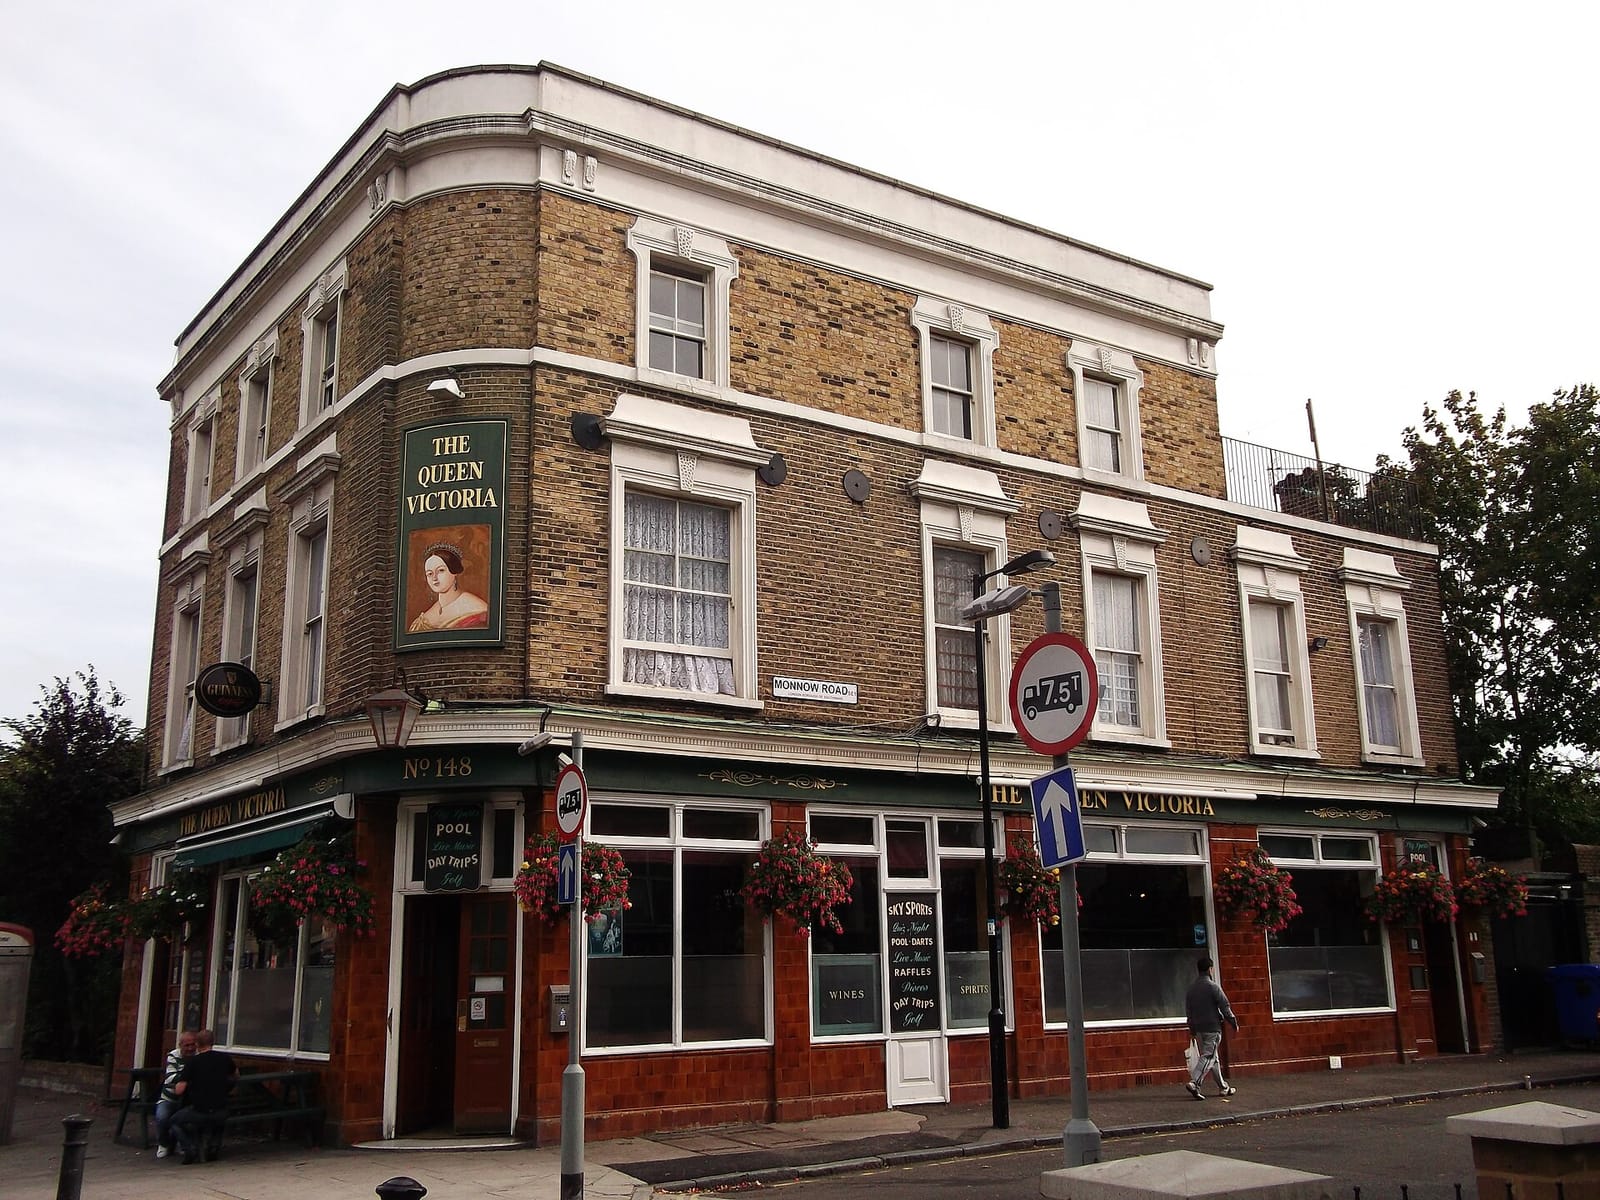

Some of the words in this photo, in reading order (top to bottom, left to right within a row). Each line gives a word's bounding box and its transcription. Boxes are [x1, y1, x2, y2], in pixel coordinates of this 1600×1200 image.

[432, 435, 471, 457] THE
[417, 461, 485, 488] QUEEN
[406, 487, 498, 515] VICTORIA
[774, 679, 819, 692] MONNOW
[822, 684, 848, 695] ROAD
[435, 756, 472, 777] 148
[180, 815, 197, 836] THE
[200, 800, 232, 832] QUEEN
[238, 787, 286, 820] VICTORIA
[1122, 791, 1215, 816] VICTORIA
[436, 823, 472, 837] POOL
[427, 855, 447, 869] DAY
[448, 853, 479, 869] TRIPS
[888, 902, 904, 916] SKY
[905, 901, 933, 916] SPORTS
[894, 967, 932, 977] RAFFLES
[829, 989, 865, 1000] WINES
[960, 984, 989, 995] SPIRITS
[893, 997, 909, 1011] DAY
[911, 997, 935, 1009] TRIPS
[902, 1011, 924, 1026] Golf
